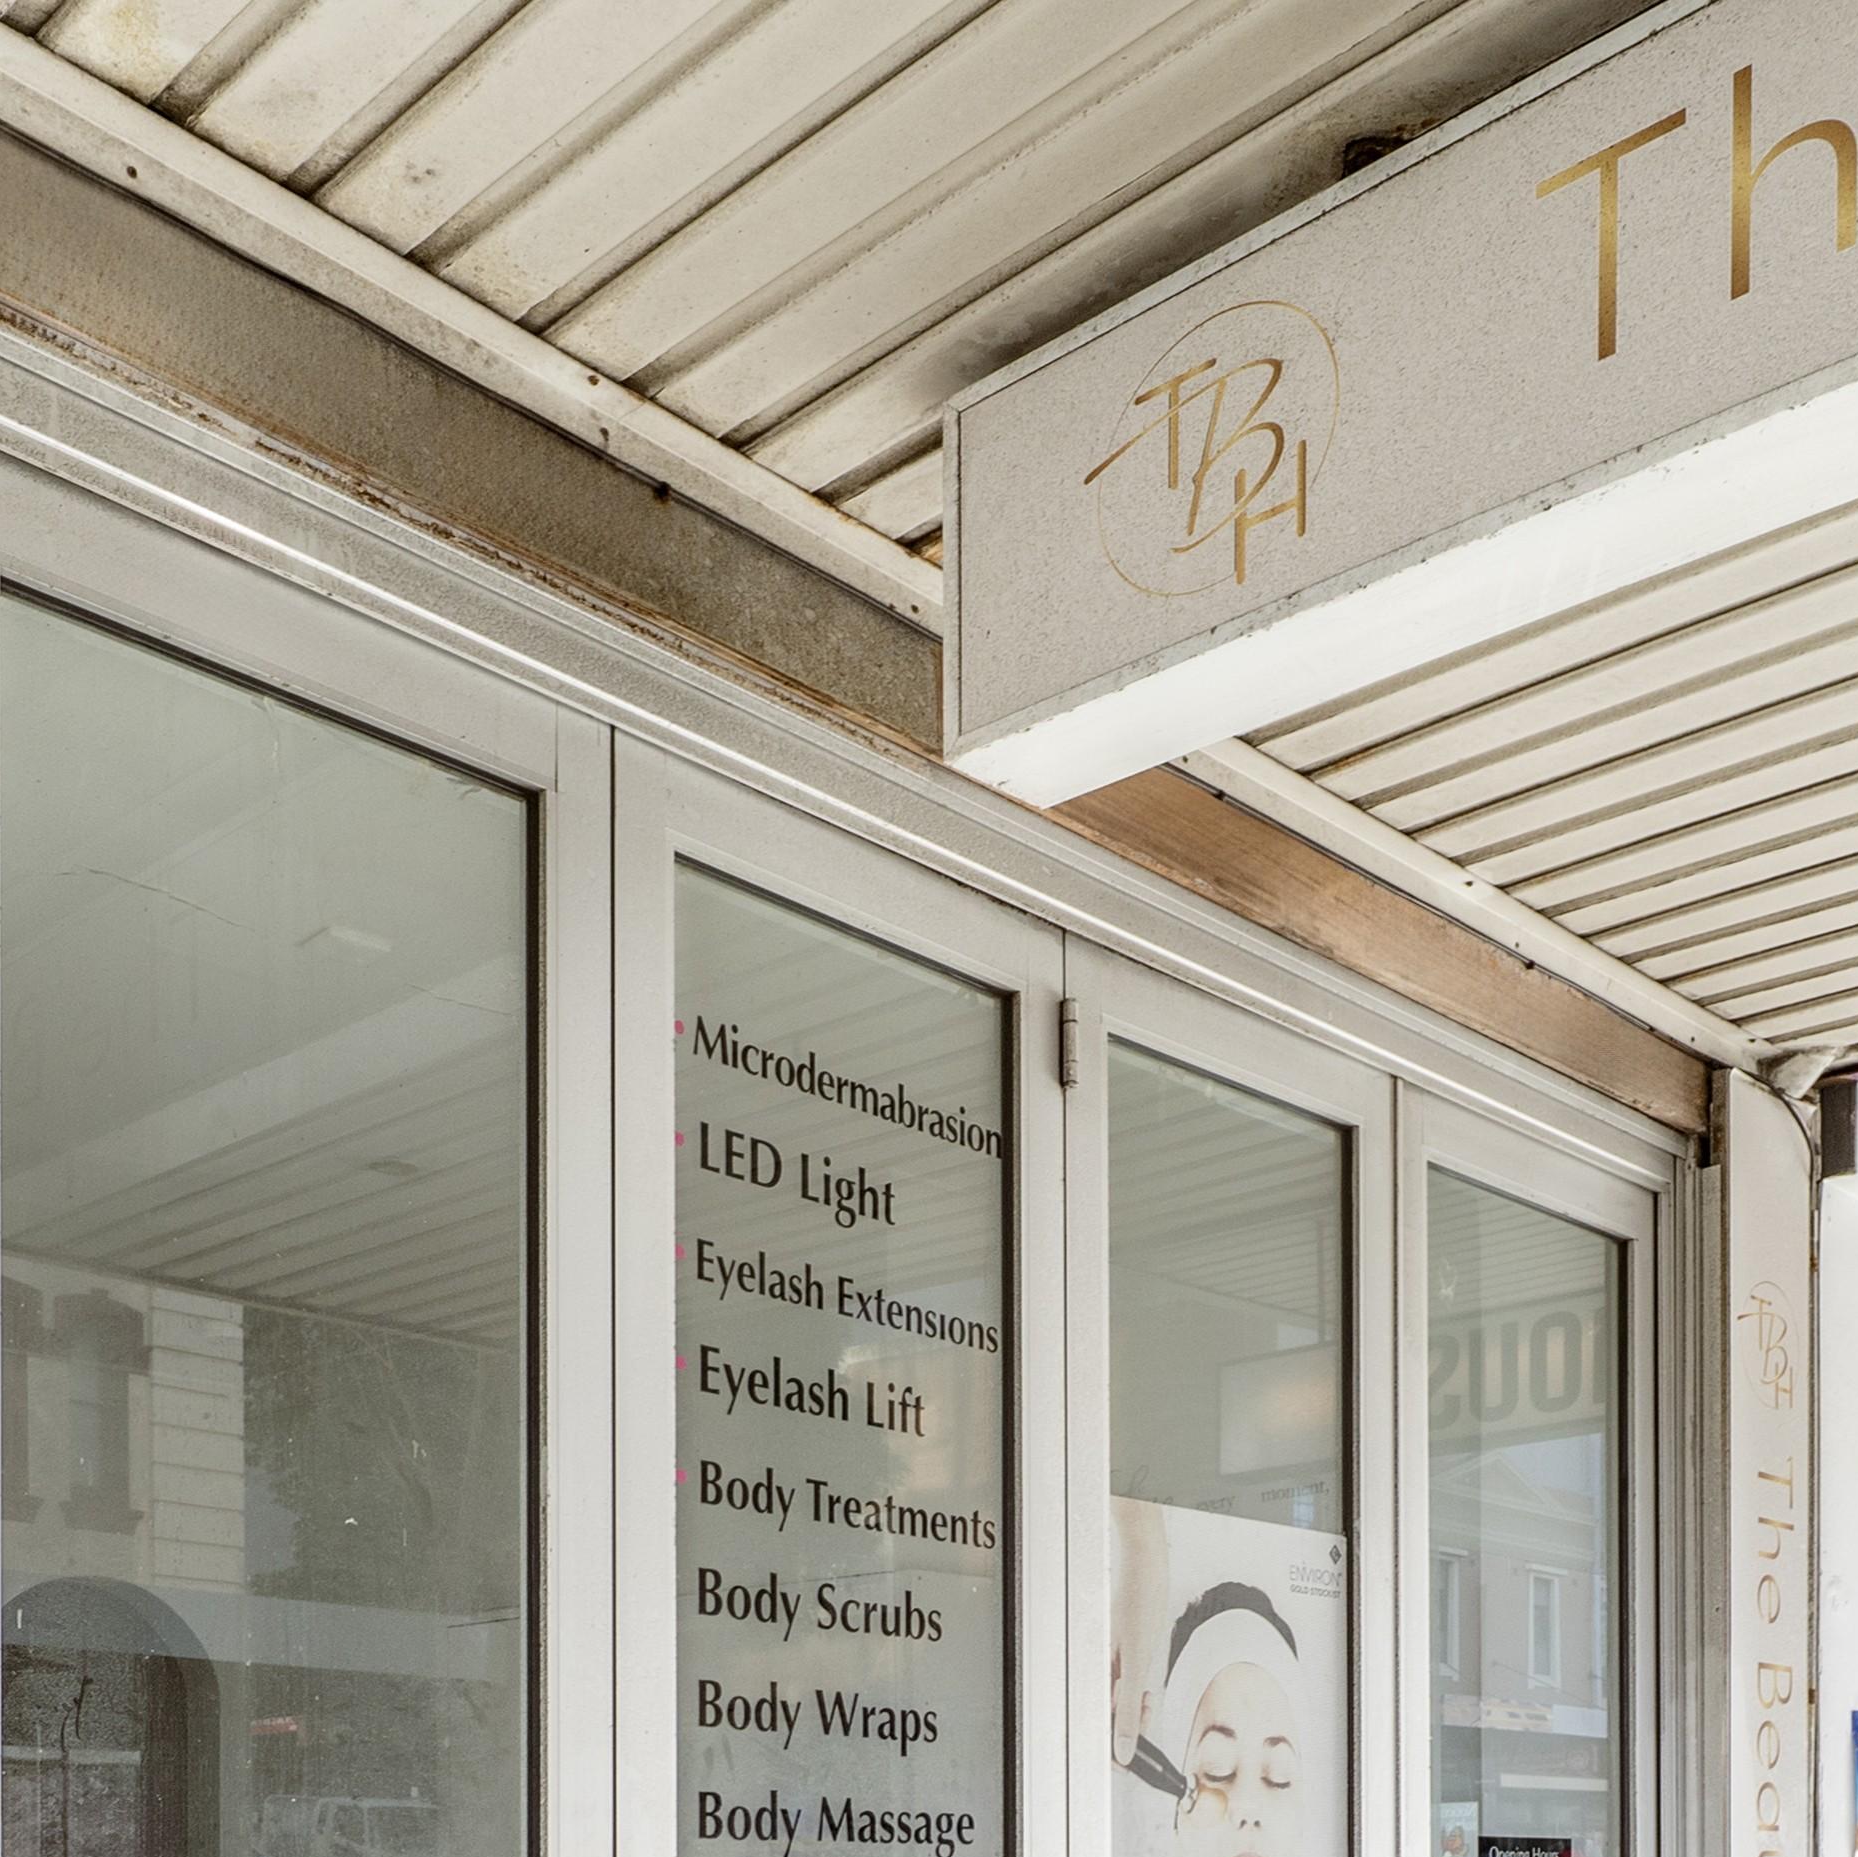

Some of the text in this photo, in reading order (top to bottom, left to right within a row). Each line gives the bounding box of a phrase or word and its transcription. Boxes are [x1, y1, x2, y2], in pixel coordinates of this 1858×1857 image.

[693, 1015, 1002, 1159] Microdermabrasion
[700, 1121, 895, 1228] LED Light
[697, 1238, 999, 1354] Eyelash Extensions
[699, 1344, 925, 1437] Eyelash Lift
[700, 1460, 996, 1550] Body Treatments
[1757, 1456, 1793, 1625] The
[698, 1567, 943, 1642] Body Scrubs
[698, 1680, 938, 1757] Body Wraps
[698, 1790, 802, 1857] Body
